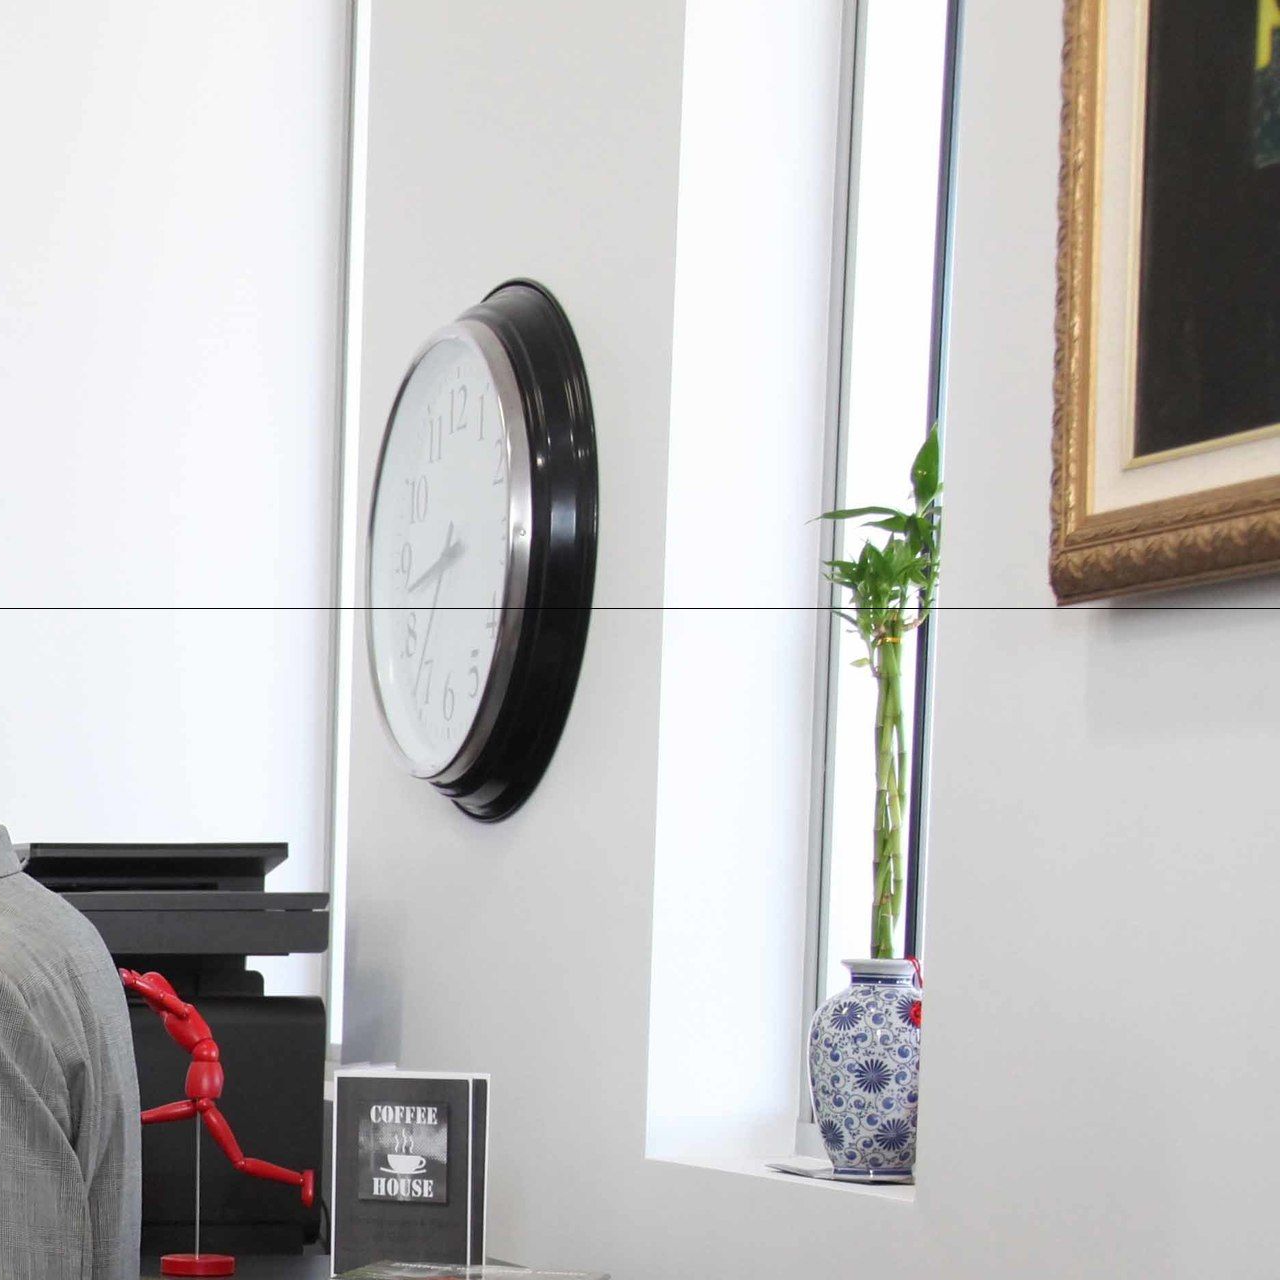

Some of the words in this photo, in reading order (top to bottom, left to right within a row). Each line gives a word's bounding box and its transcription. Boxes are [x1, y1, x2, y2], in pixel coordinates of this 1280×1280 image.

[449, 385, 467, 434] 12
[370, 1105, 438, 1125] COFFEE
[373, 1177, 434, 1197] HOUSE
